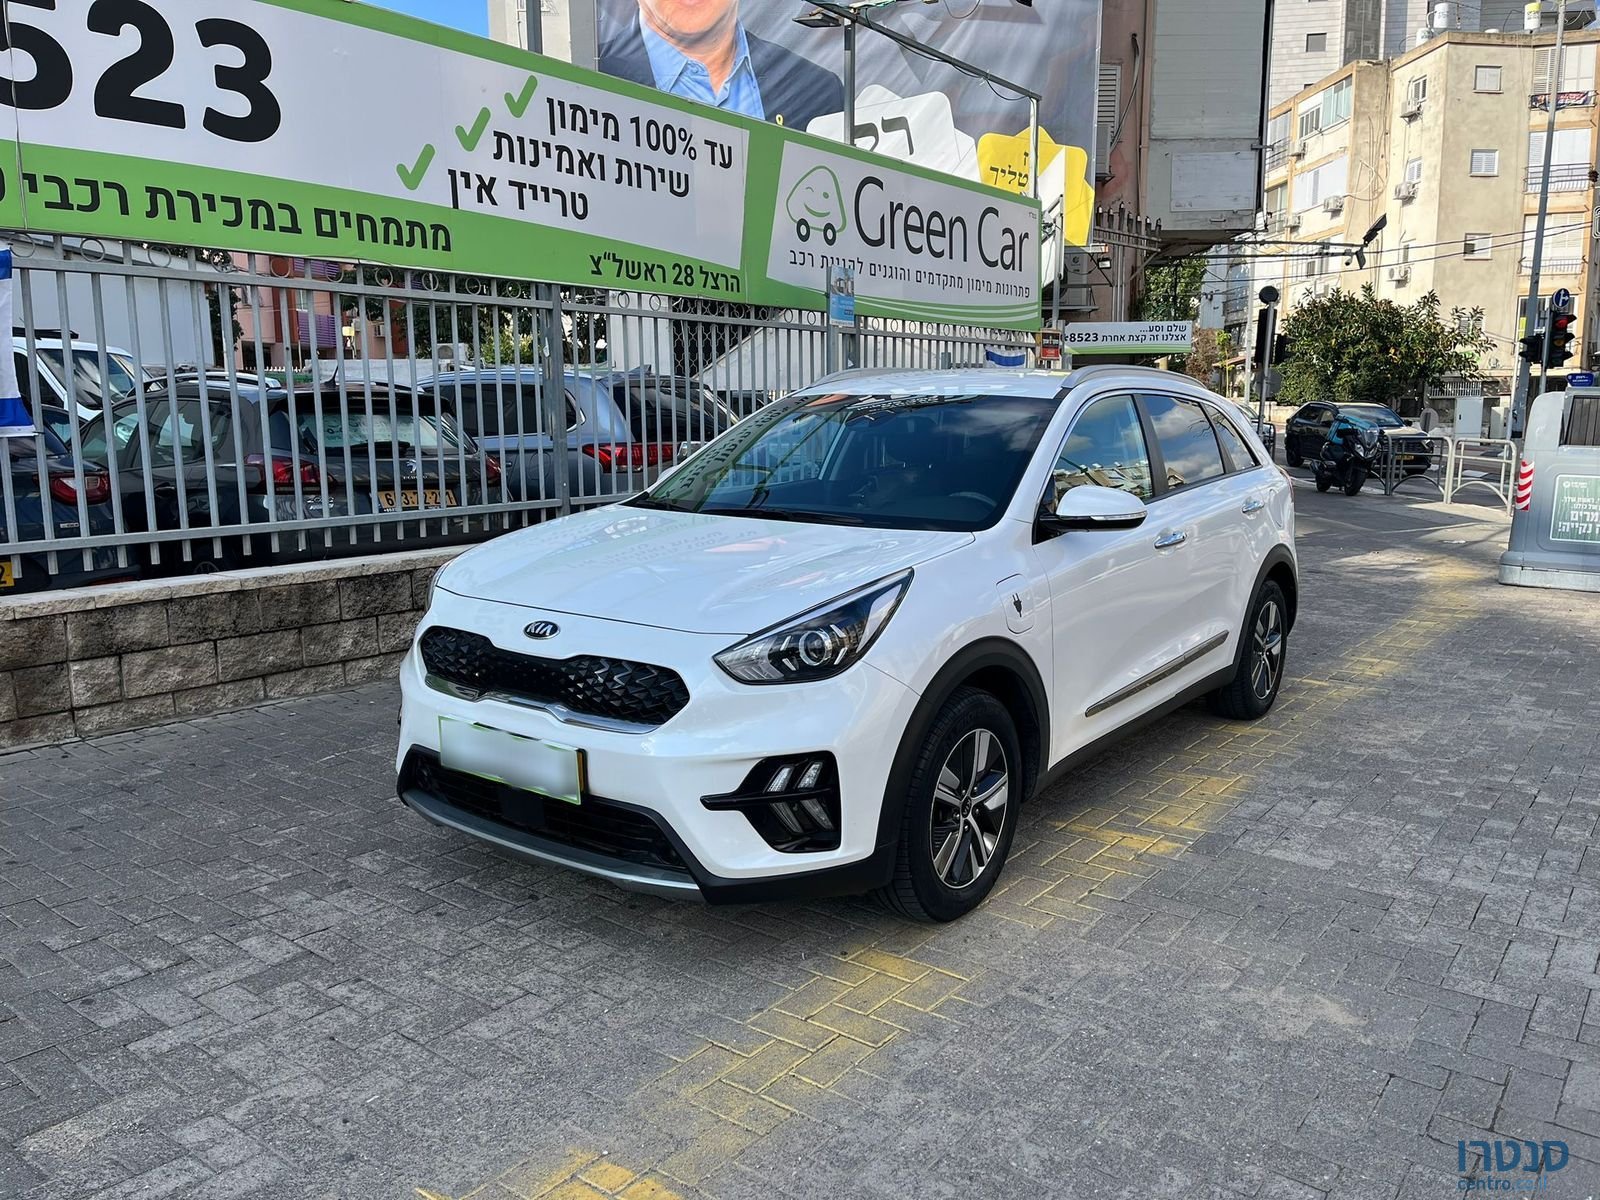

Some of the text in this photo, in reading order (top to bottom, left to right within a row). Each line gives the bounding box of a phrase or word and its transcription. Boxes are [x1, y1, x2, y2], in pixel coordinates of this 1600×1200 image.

[0, 0, 281, 142] 523
[546, 97, 733, 169] עד 100% מימון
[492, 130, 689, 197] שירות ואמינות
[22, 172, 130, 216] רכבי
[448, 168, 588, 221] טרייד אין
[145, 185, 302, 234] במכירת
[313, 207, 452, 252] מתמחים
[854, 175, 1029, 272] Green Car
[789, 249, 814, 268] רכב
[673, 262, 694, 287] 28
[700, 264, 741, 293] הרצל
[869, 262, 911, 281] והוגנים
[915, 270, 963, 290] מתקדמים
[967, 277, 992, 294] מימון
[995, 281, 1030, 298] פתרונות
[1101, 334, 1126, 342] אחרת
[1128, 334, 1147, 343] קצת
[1162, 333, 1187, 341] אצלנו
[1167, 323, 1187, 332] שלם
[526, 622, 553, 636] KIA
